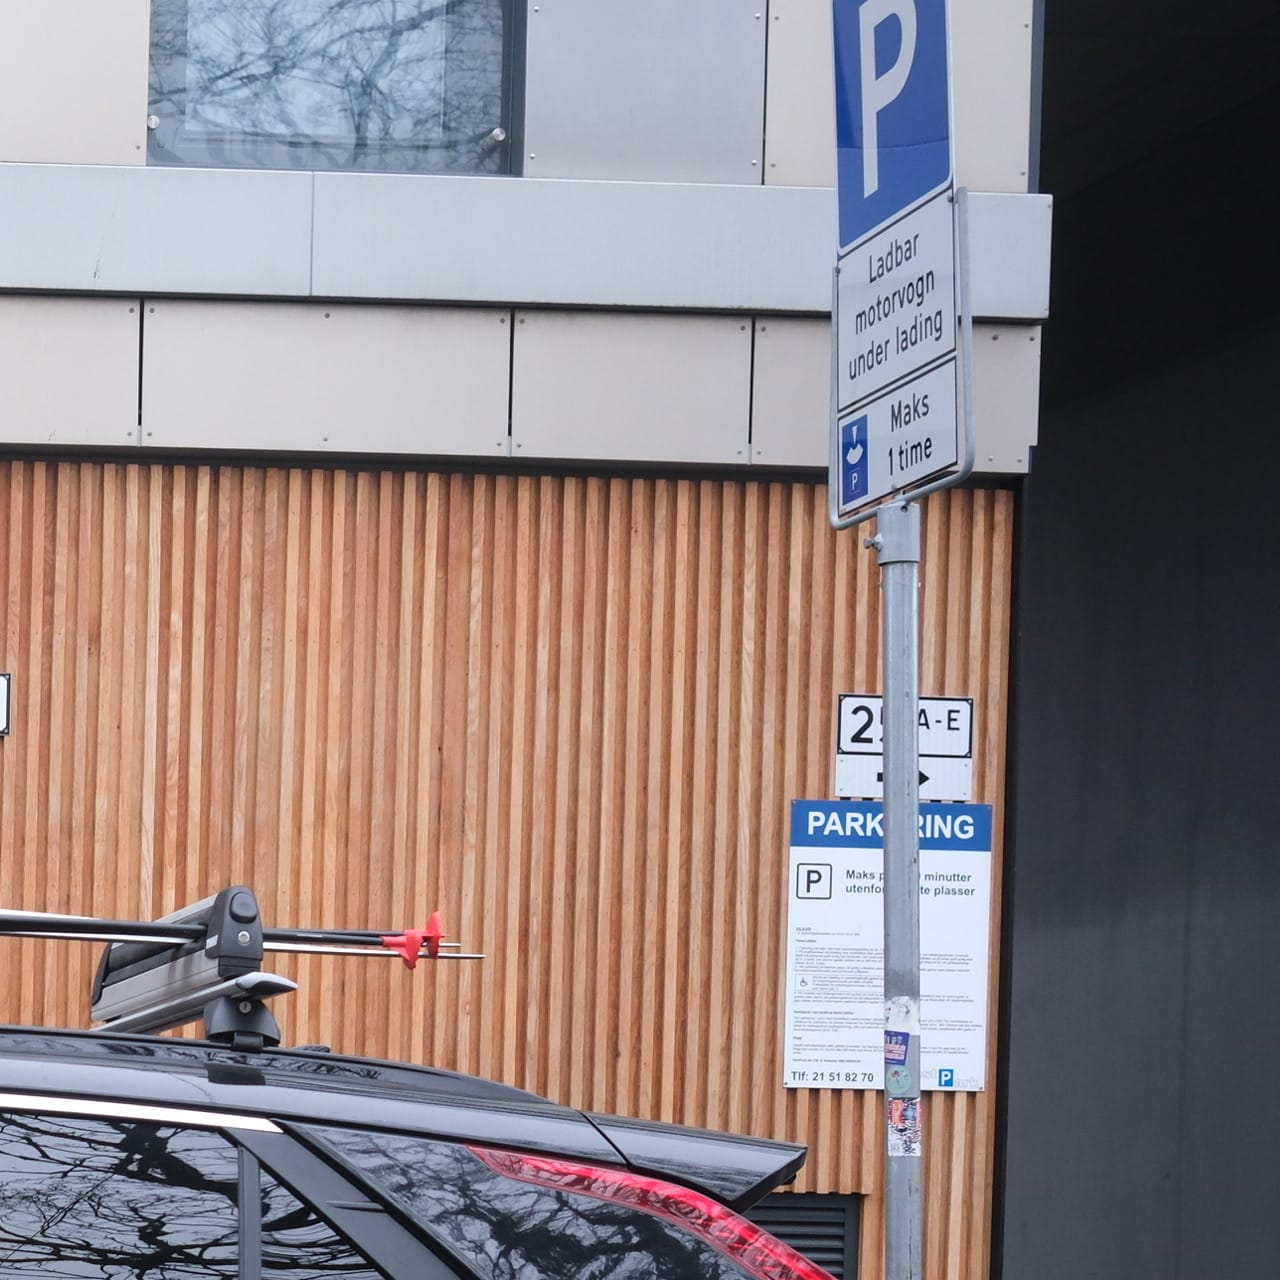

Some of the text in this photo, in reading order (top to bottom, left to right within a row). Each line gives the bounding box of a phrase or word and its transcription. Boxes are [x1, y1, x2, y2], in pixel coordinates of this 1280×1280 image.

[859, 0, 918, 199] P
[868, 233, 920, 284] Ladbar
[855, 270, 935, 335] motorvogn
[849, 309, 943, 381] under lading
[891, 393, 930, 433] Maks
[888, 437, 933, 476] 1 time
[850, 705, 884, 744] 2
[807, 811, 975, 840] PARKING
[806, 869, 822, 893] P
[846, 869, 876, 880] Maks
[925, 873, 972, 882] minutter
[934, 886, 976, 897] plasser
[792, 1071, 874, 1082] Tlf: 21 51 82 70
